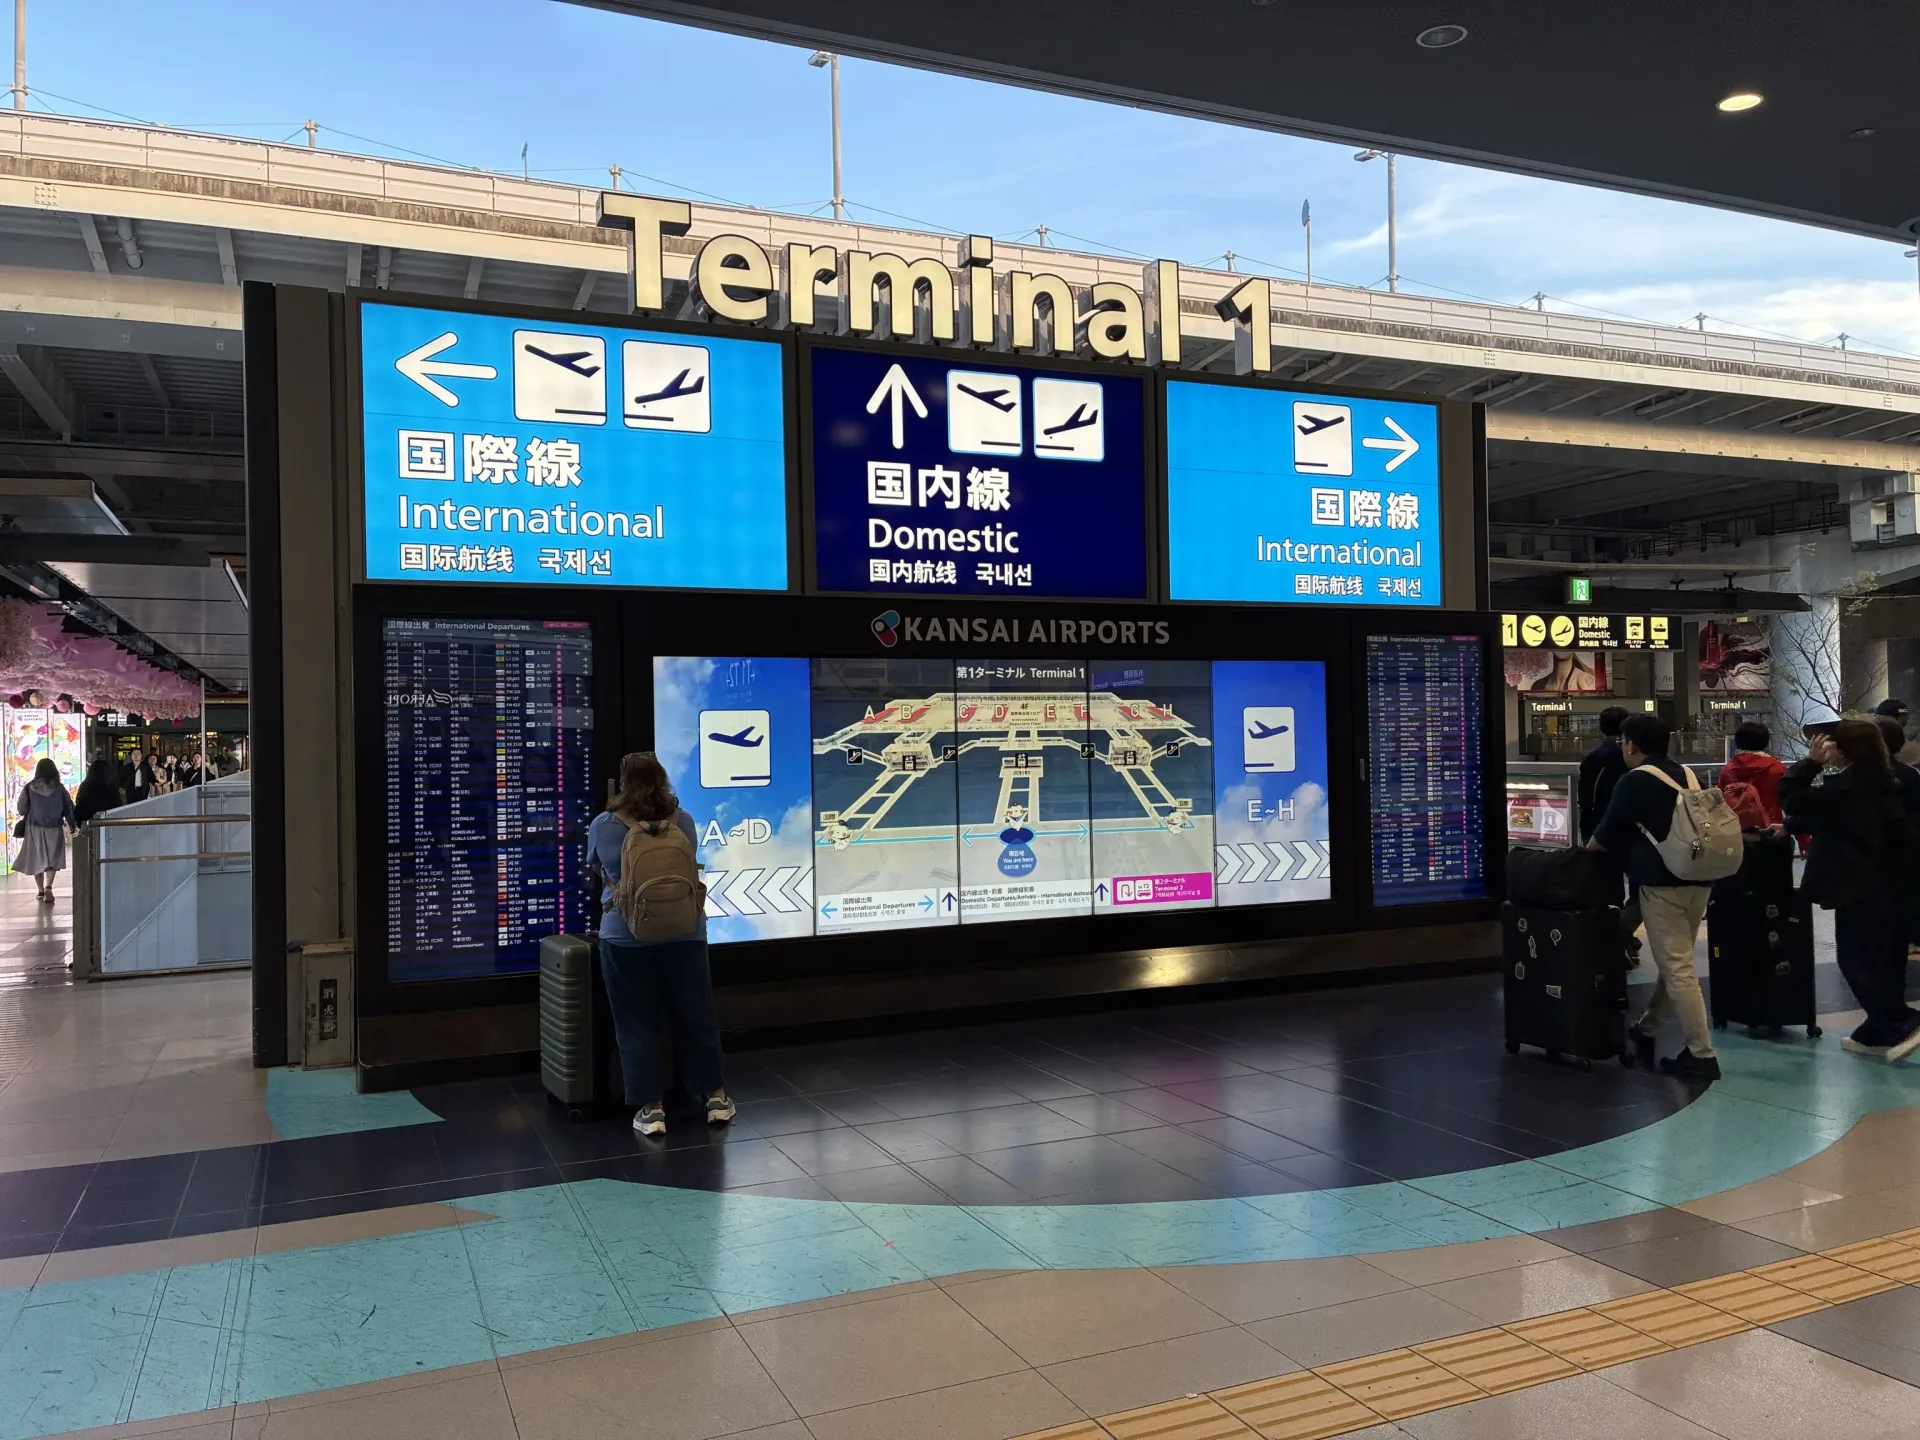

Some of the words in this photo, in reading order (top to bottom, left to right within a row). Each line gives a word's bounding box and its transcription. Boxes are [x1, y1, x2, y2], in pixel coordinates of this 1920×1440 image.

[599, 191, 1181, 363] Terminal
[1213, 277, 1272, 373] 1
[397, 428, 584, 489] 国際線
[867, 461, 1011, 511] 国内線
[1310, 486, 1420, 531] 国際線
[398, 494, 665, 540] International
[868, 518, 1019, 554] Domestic
[399, 542, 515, 574] 国际航线
[1256, 535, 1422, 568] International
[537, 547, 613, 577] 국제선
[869, 559, 957, 585] 国内航线
[975, 562, 1033, 587] 국내선
[1294, 574, 1364, 597] 国际航线
[1377, 577, 1422, 599] 국제선
[434, 622, 486, 630] International
[487, 622, 530, 631] Departures
[904, 616, 1019, 643] KANSAI
[1027, 618, 1171, 645] AIRPORTS
[1578, 616, 1609, 629] 国内線
[1578, 629, 1611, 639] Domestic
[956, 666, 1026, 680] 第1ターミナル
[1030, 667, 1077, 679] Terminal
[1078, 667, 1086, 679] 1
[863, 704, 876, 720] A
[901, 704, 912, 719] B
[959, 703, 970, 719] C
[994, 704, 1005, 718] D
[1046, 703, 1056, 718] E
[1130, 703, 1141, 718] G
[1162, 703, 1173, 718] H
[1531, 702, 1566, 712] Terminal
[1568, 702, 1573, 711] 1
[1709, 700, 1741, 710] Terminal
[1742, 700, 1747, 710] 1
[1040, 891, 1073, 899] International
[842, 903, 882, 913] International
[882, 901, 916, 910] Departures
[323, 988, 336, 1033] 消火器
